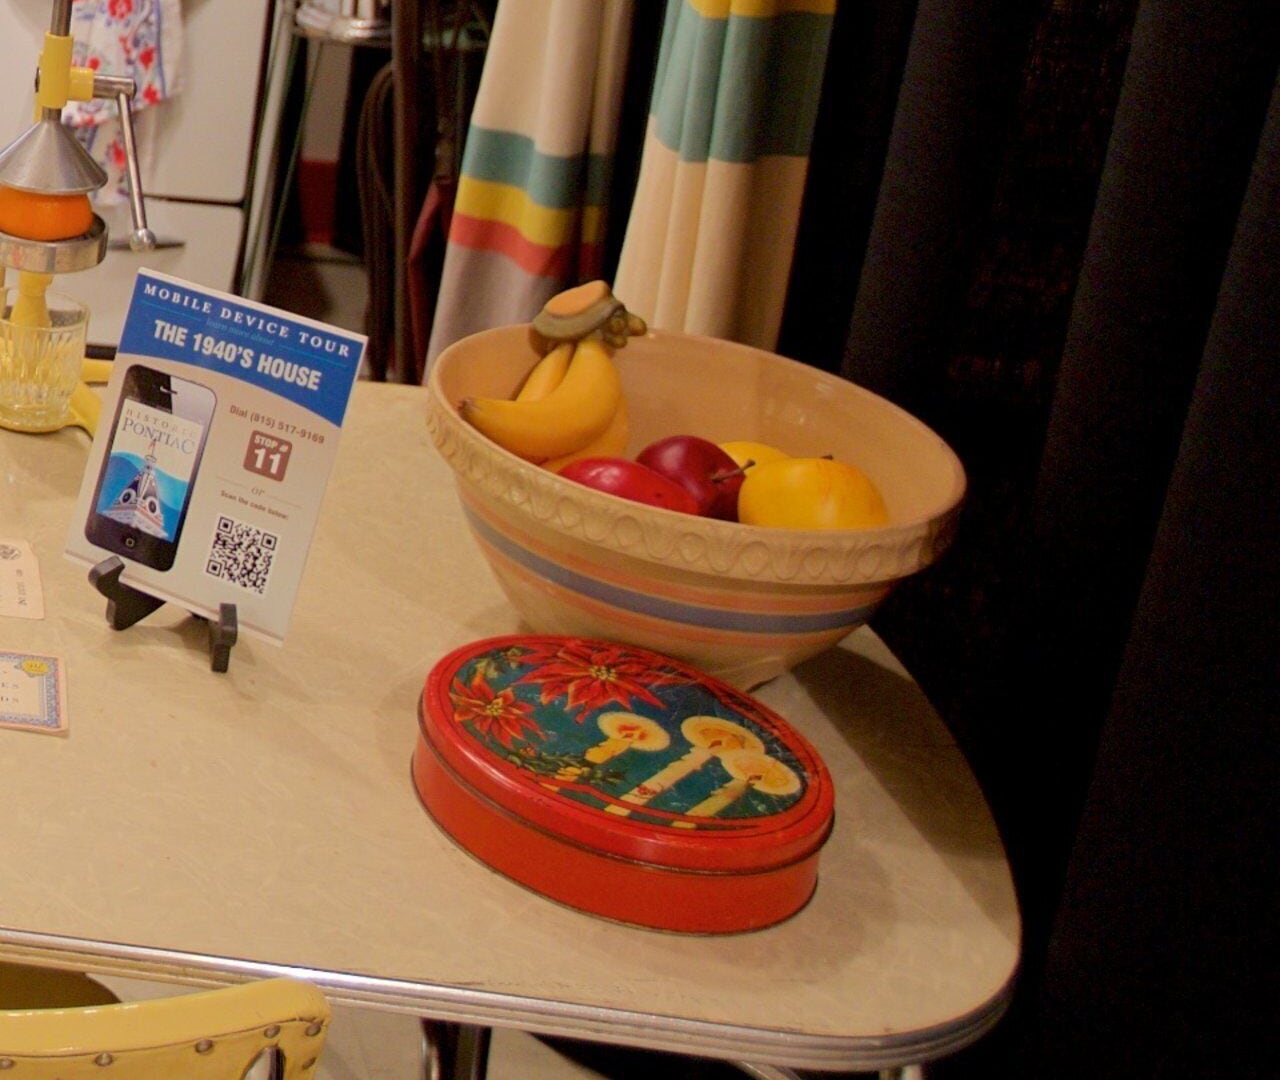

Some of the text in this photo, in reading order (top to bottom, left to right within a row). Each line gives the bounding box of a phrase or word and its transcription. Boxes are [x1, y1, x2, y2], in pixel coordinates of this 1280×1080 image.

[143, 283, 351, 358] MOBILE DEVICE TOUR
[153, 319, 322, 391] THE 1940'S HOUSE
[229, 404, 248, 419] Dial
[250, 411, 276, 429] (815)
[121, 416, 196, 455] PONTIAC
[254, 434, 279, 450] STOP
[254, 448, 282, 475] 11
[220, 489, 237, 502] Scan
[251, 487, 265, 497] or
